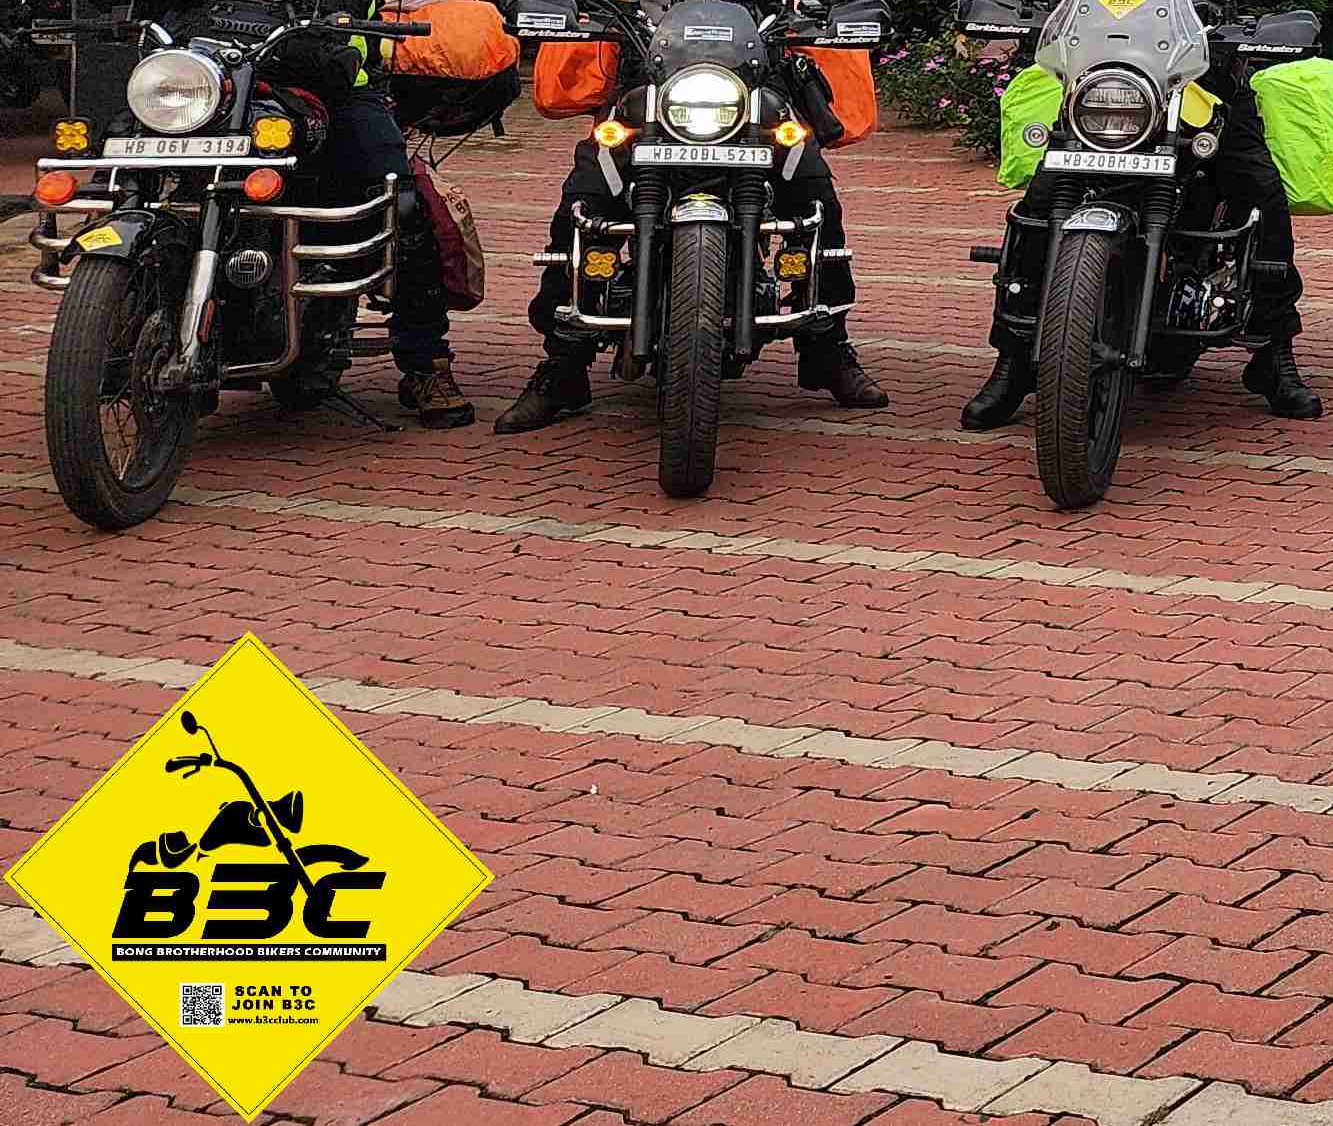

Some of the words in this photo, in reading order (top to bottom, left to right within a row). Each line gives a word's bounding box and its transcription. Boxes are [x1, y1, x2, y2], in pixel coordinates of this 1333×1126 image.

[124, 139, 146, 154] WB
[155, 139, 190, 154] 06V
[202, 138, 247, 154] 3194
[653, 147, 673, 161] WB
[679, 146, 721, 162] 20BL
[727, 148, 768, 162] 5213
[1063, 153, 1082, 167] WB
[1131, 156, 1171, 171] 9315
